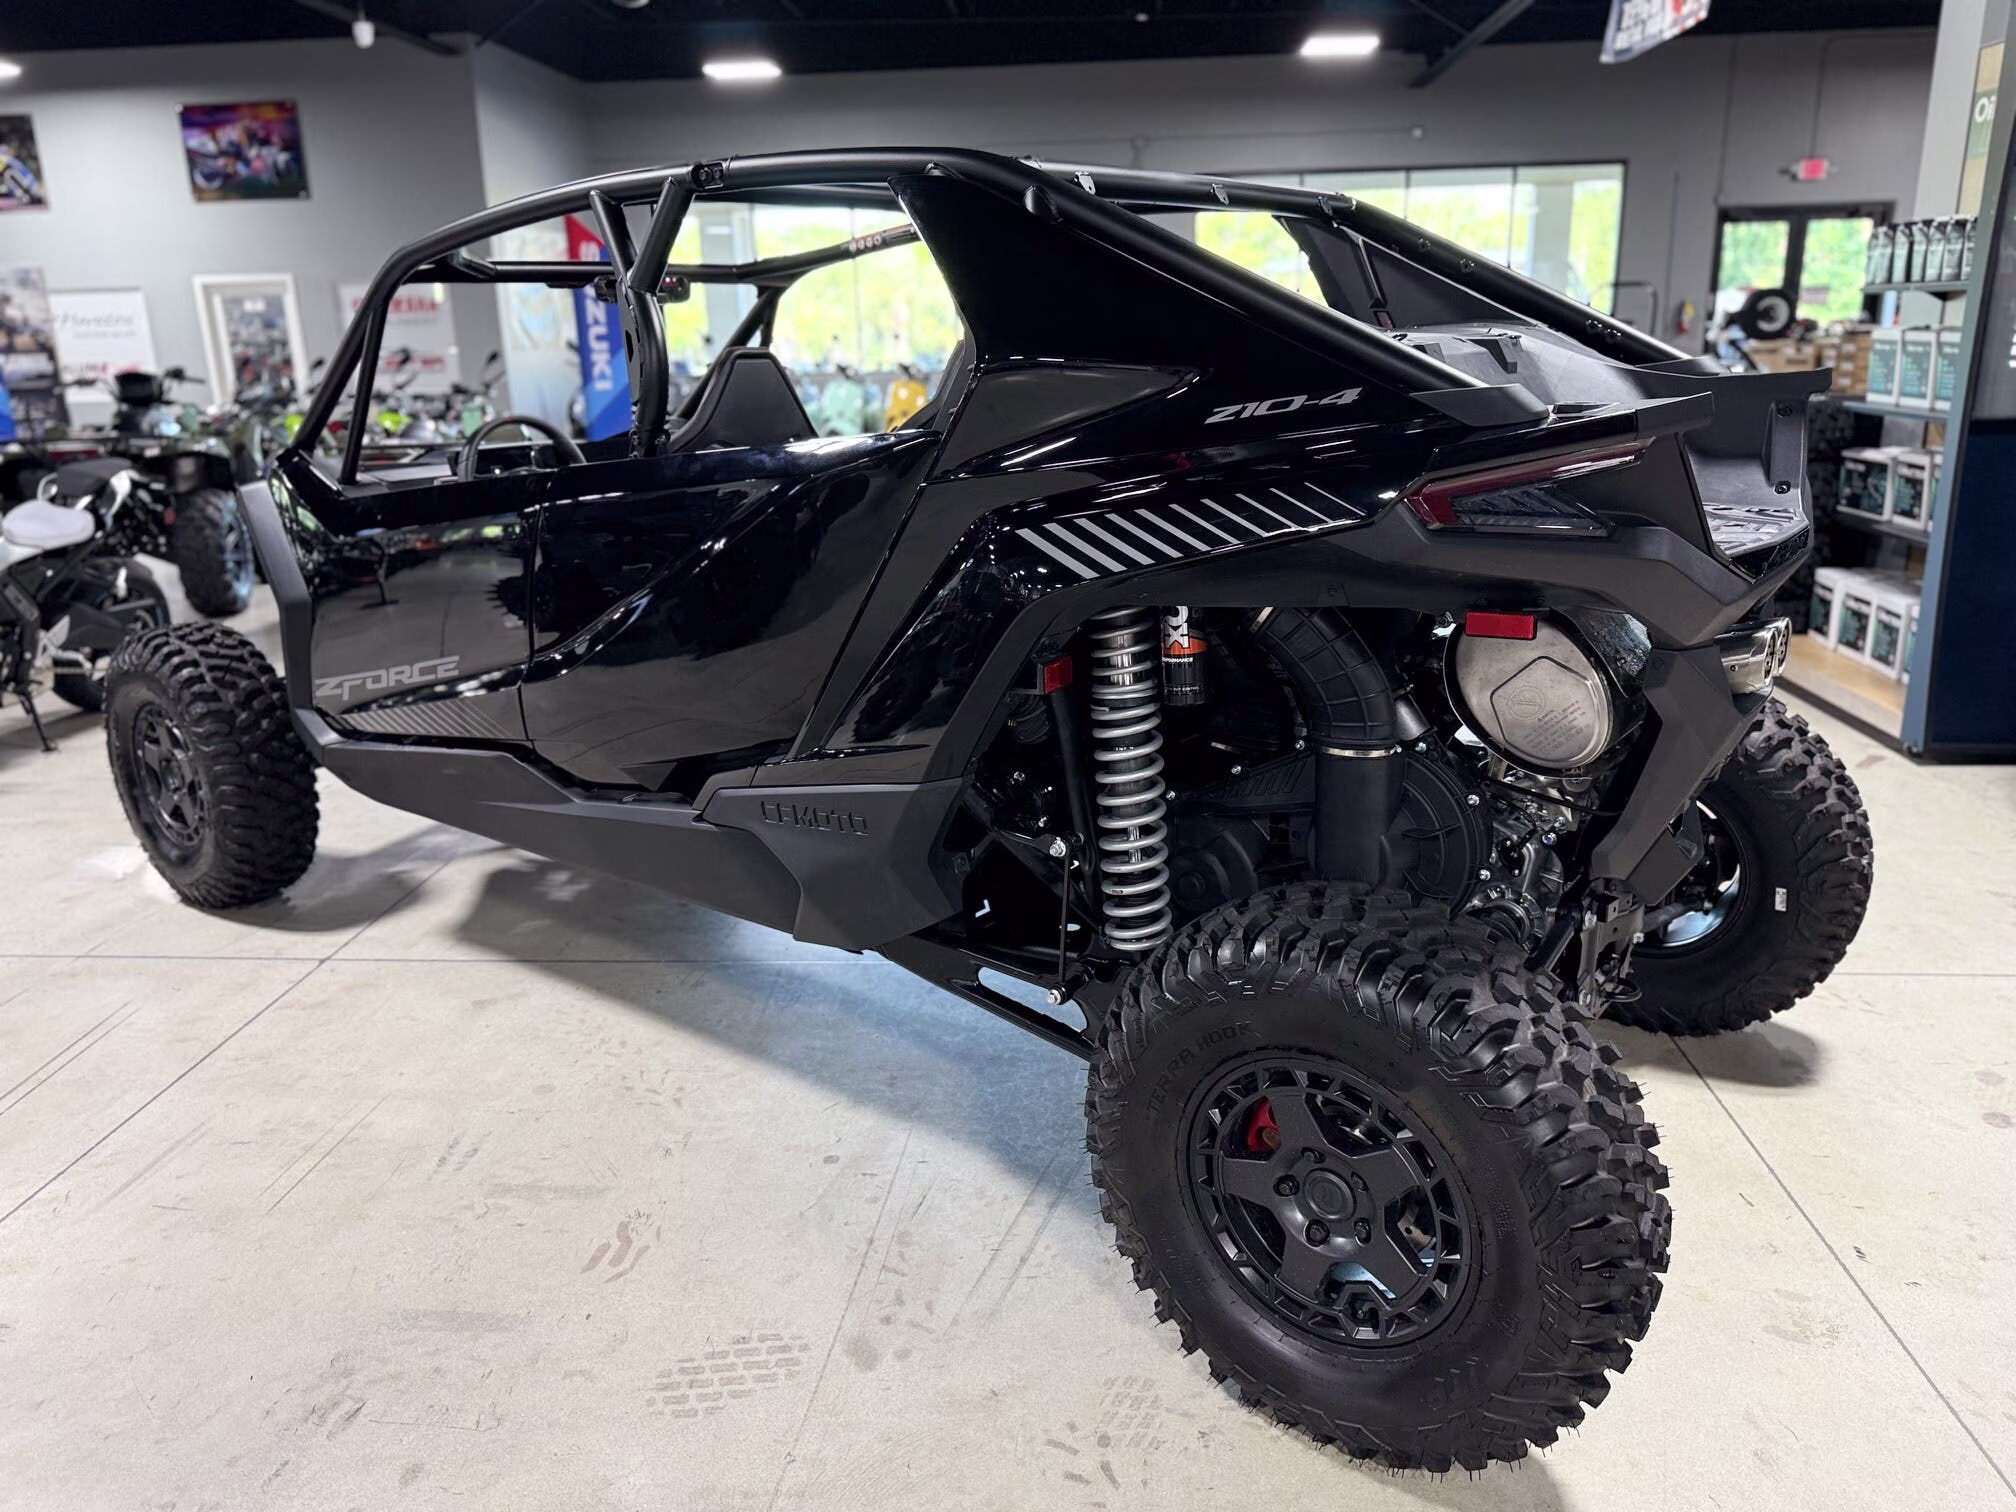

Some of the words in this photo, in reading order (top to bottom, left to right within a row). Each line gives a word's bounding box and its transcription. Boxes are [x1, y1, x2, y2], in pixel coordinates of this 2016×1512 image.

[1974, 95, 1996, 123] Oi
[1163, 605, 1190, 648] OX
[315, 655, 460, 700] ZFORCE
[761, 800, 869, 836] CFMOTO
[1146, 1047, 1197, 1113] TERRA
[1196, 1021, 1252, 1051] HOOK
